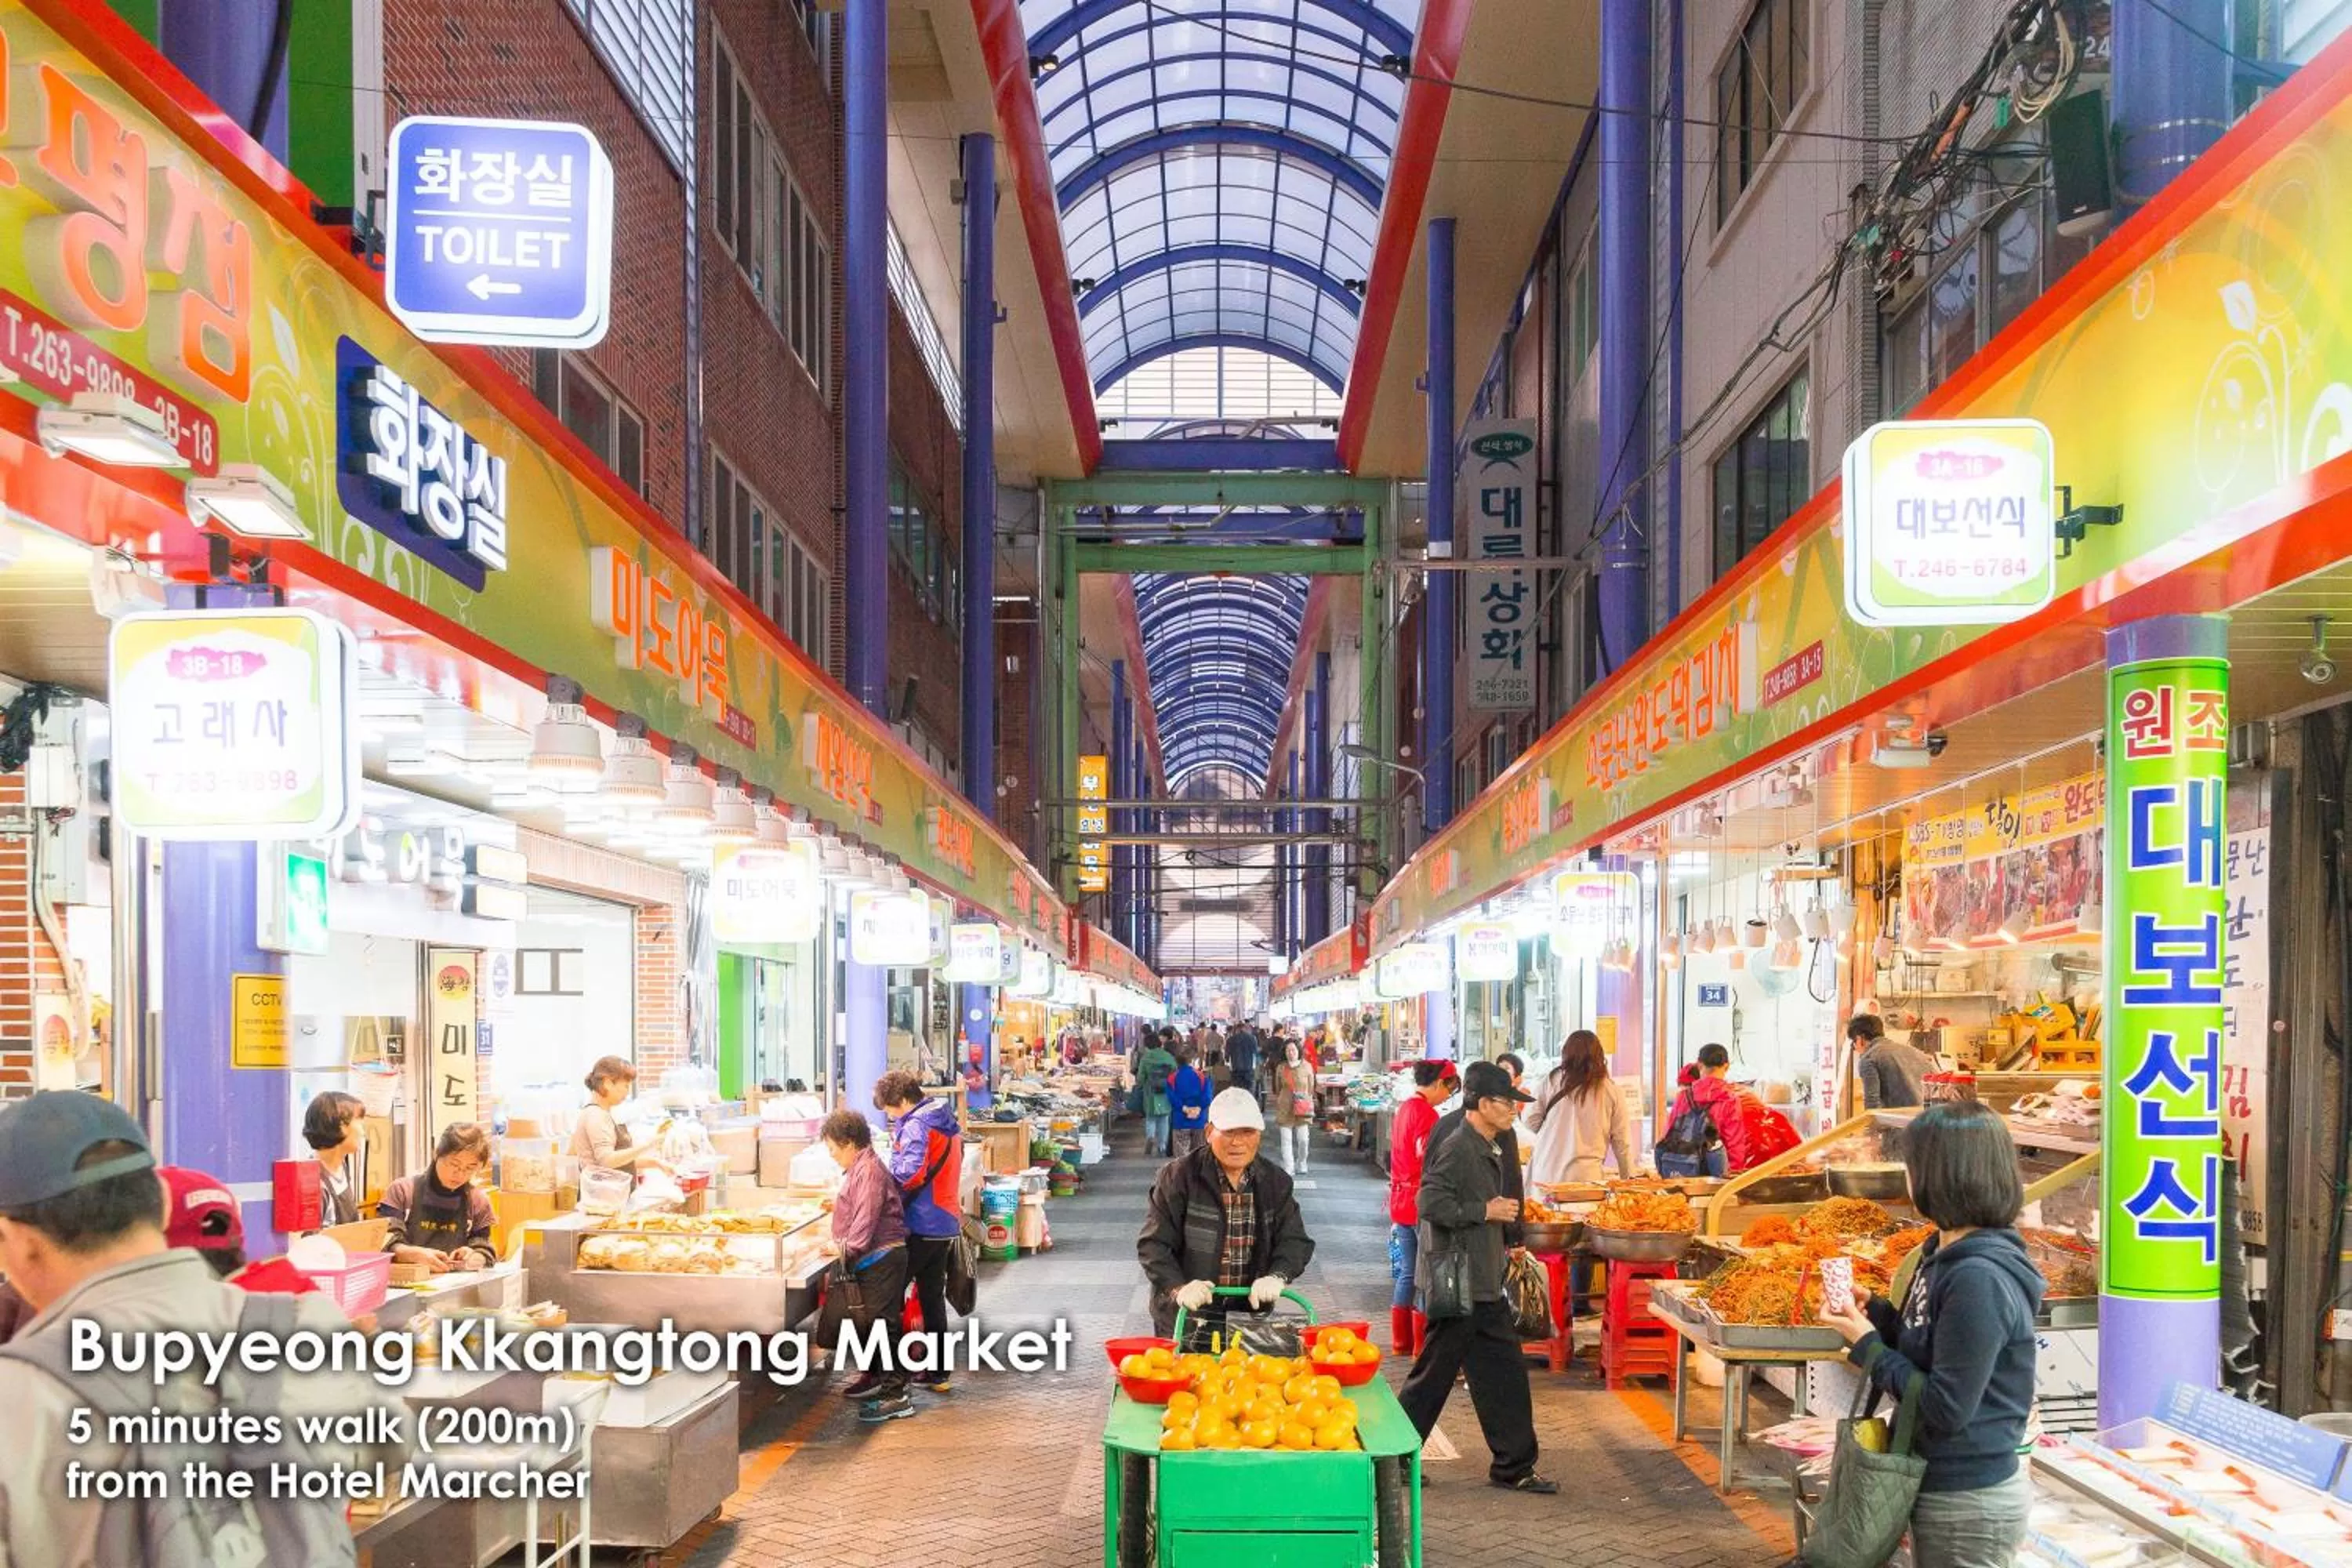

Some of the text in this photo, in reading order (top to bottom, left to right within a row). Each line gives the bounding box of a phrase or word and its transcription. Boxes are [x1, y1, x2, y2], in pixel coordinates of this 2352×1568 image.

[414, 147, 573, 208] 화장실
[0, 26, 251, 404] 평점
[415, 225, 572, 269] TOILET
[366, 364, 507, 571] 화장실
[1896, 495, 2026, 539] 대보선식
[1893, 557, 2027, 578] T.246-6784
[612, 545, 728, 724] 미도어묵
[152, 699, 288, 749] 고래사
[2122, 686, 2226, 759] 원조
[2123, 778, 2222, 1262] 대보선식
